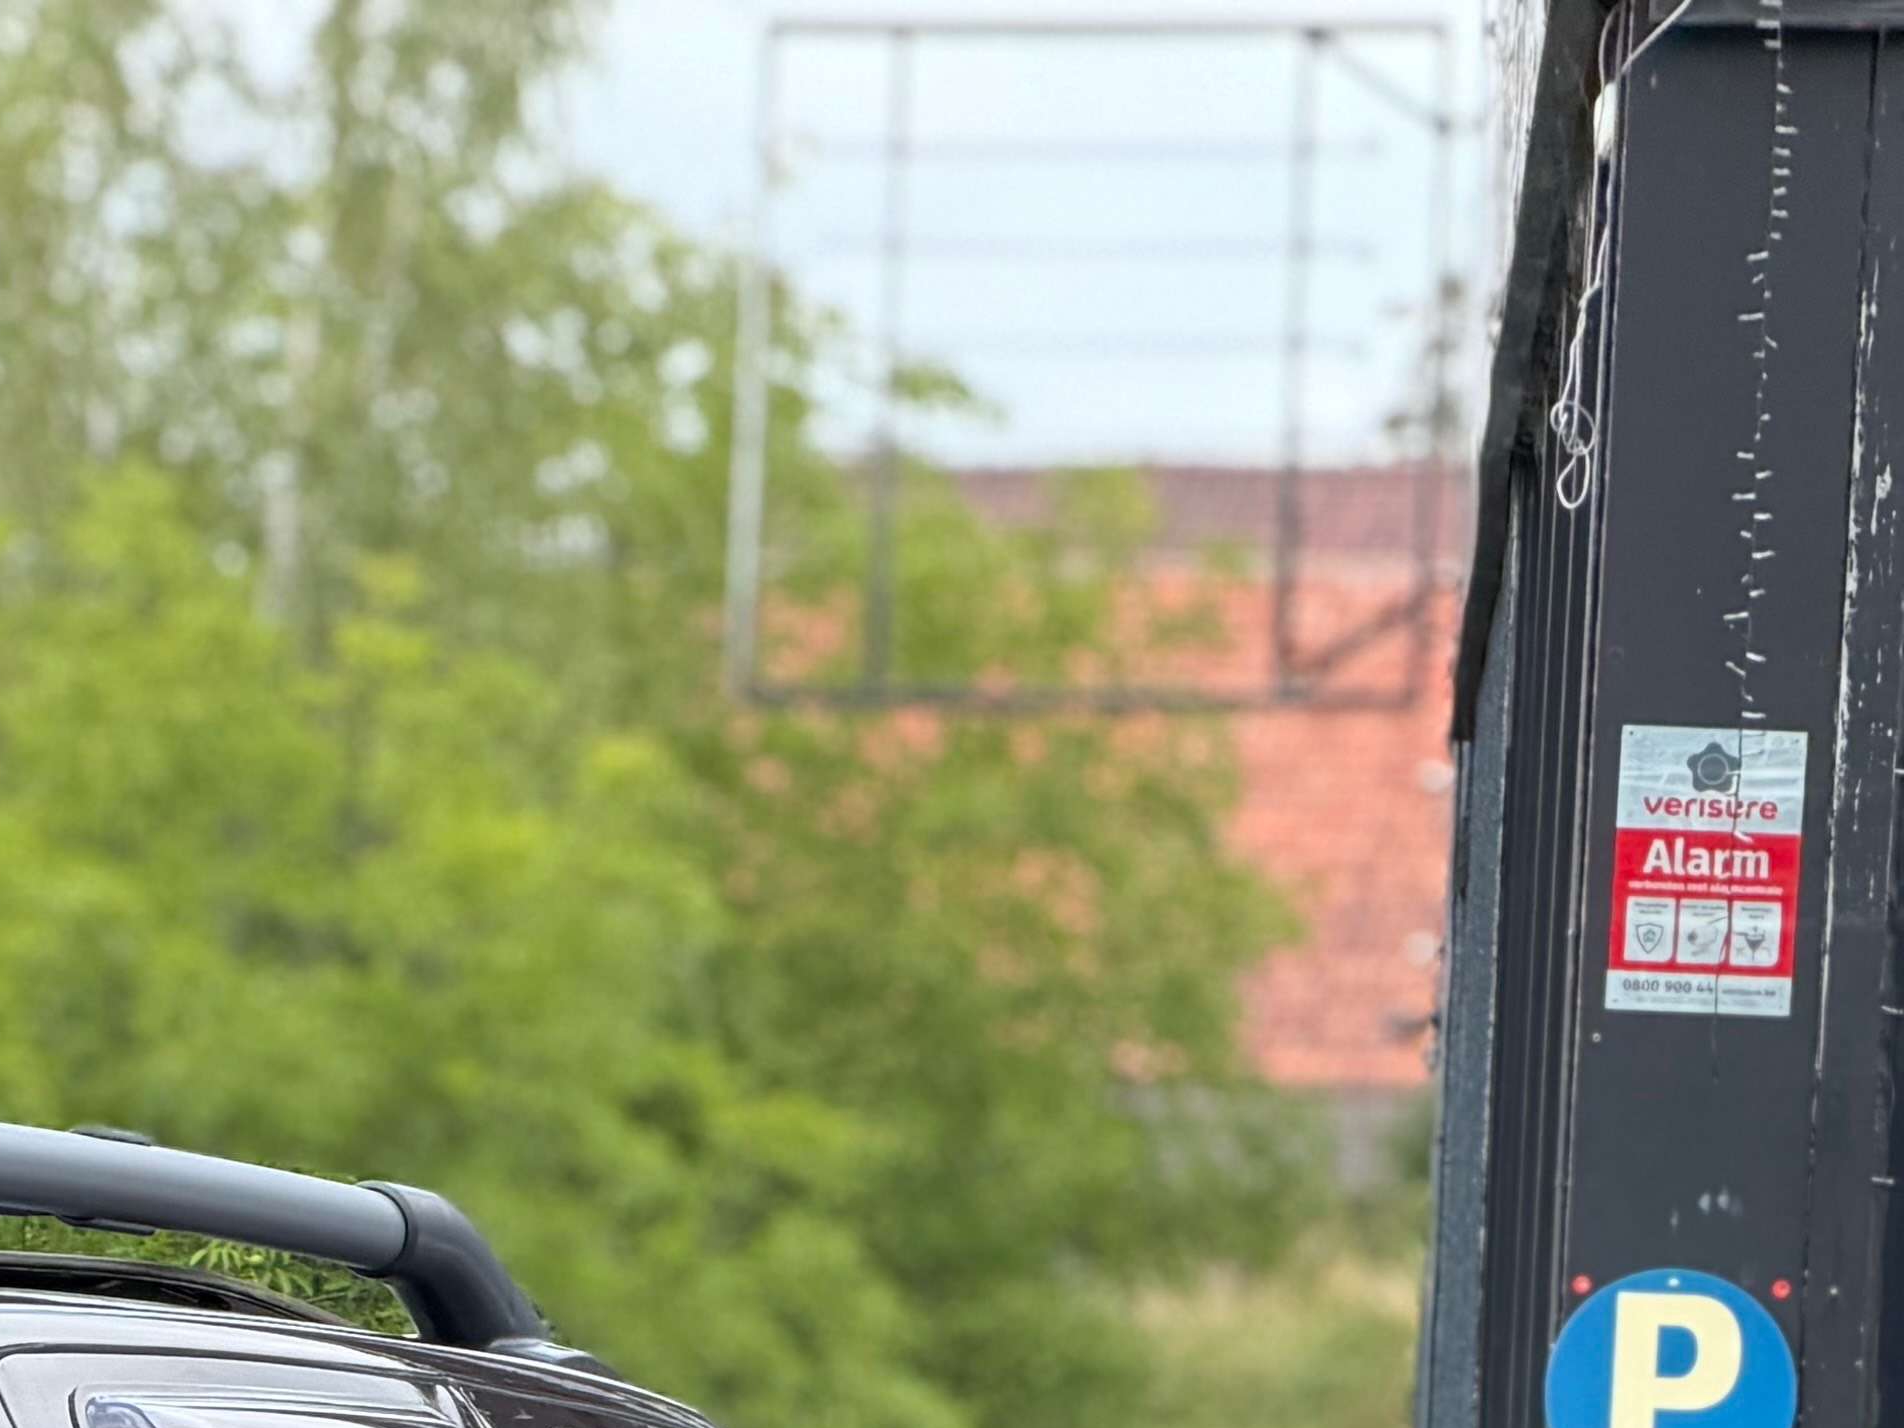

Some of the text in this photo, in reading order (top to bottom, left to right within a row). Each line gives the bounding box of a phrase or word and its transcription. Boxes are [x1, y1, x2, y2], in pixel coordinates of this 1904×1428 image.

[1643, 796, 1779, 820] verisure
[1642, 836, 1770, 879] Alarm
[1622, 978, 1660, 993] 0800
[1665, 981, 1693, 994] 900
